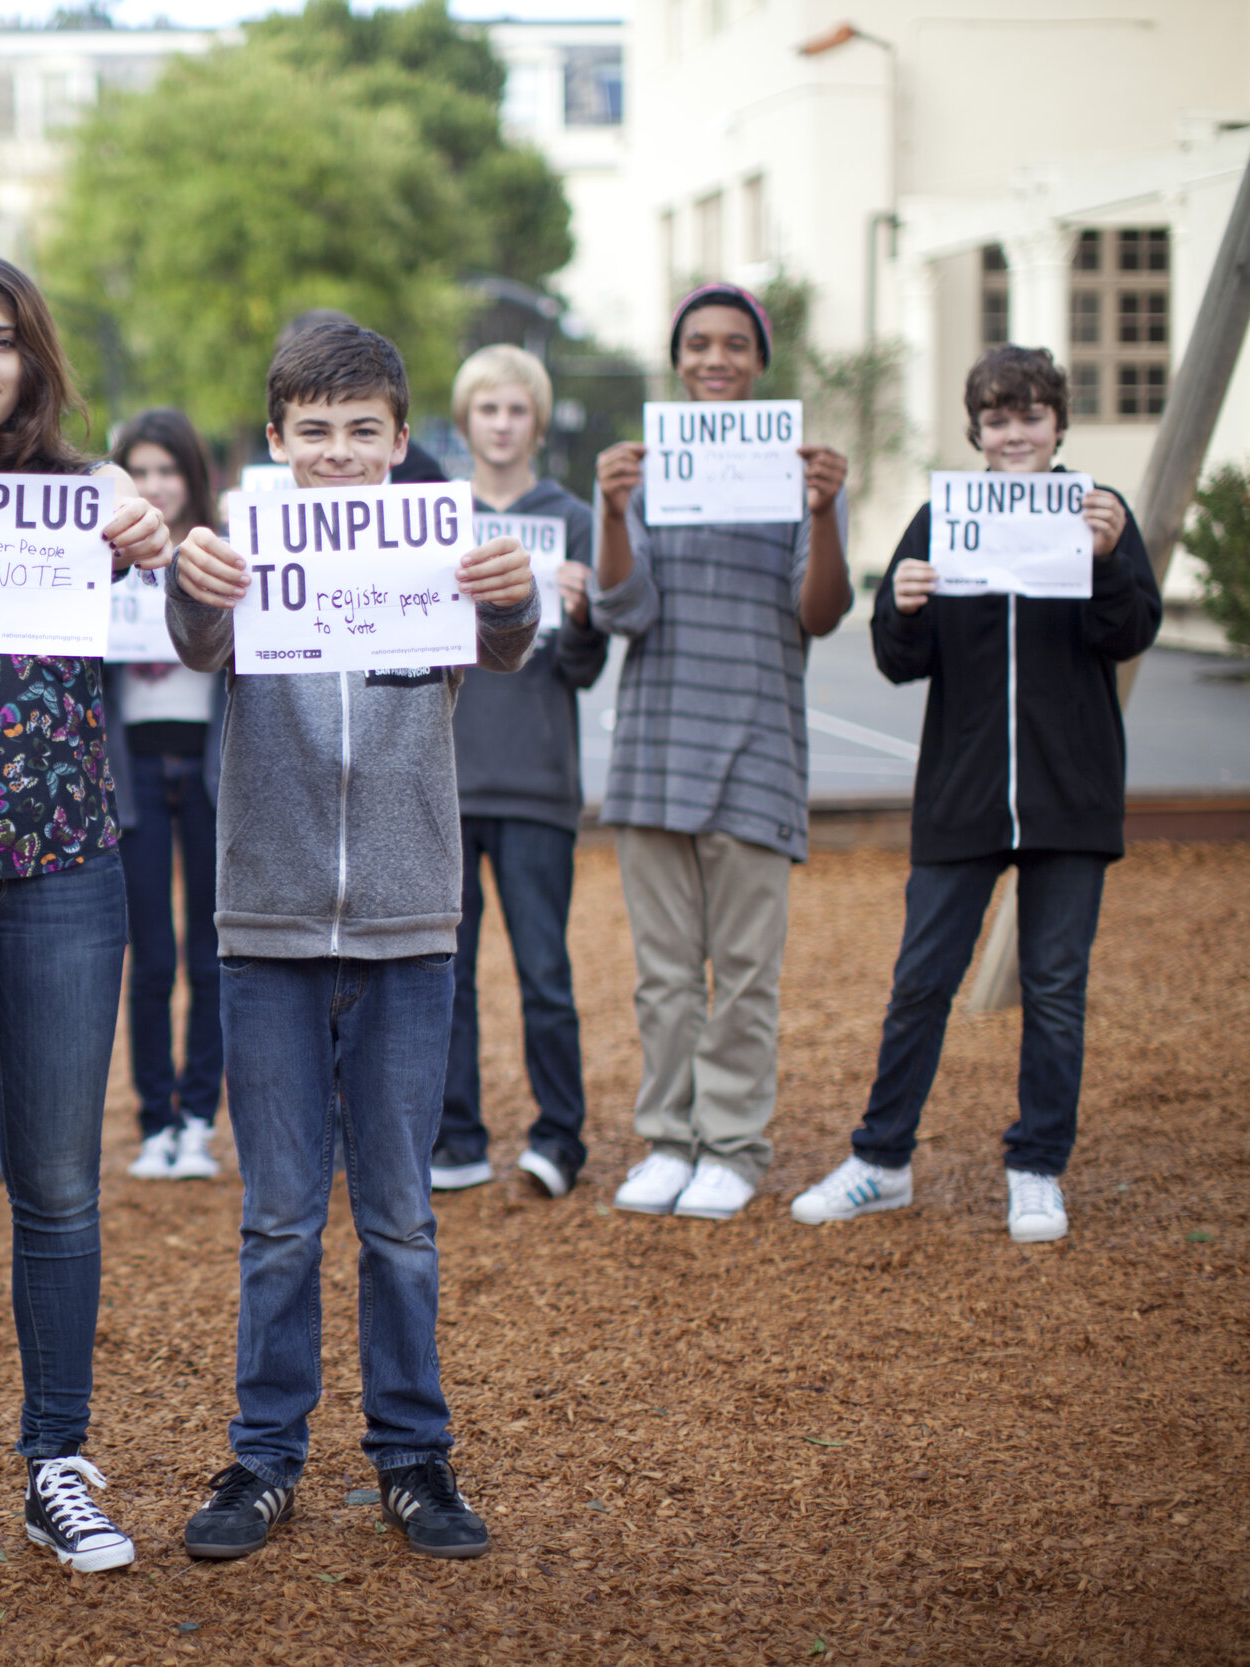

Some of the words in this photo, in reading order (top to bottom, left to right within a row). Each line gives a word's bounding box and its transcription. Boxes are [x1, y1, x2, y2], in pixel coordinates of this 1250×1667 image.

[659, 413, 665, 444] I
[680, 410, 792, 444] UNPLUG
[660, 450, 693, 480] TO
[945, 482, 951, 513] I
[967, 482, 1084, 514] UNPLUG
[249, 505, 259, 555] I
[282, 496, 458, 553] UNPLUG
[946, 520, 979, 551] TO
[20, 538, 65, 562] People
[252, 562, 306, 612] TO
[316, 584, 388, 624] register
[399, 588, 441, 616] people
[314, 616, 331, 635] to
[347, 620, 377, 635] vote
[255, 650, 303, 660] REBOOT
